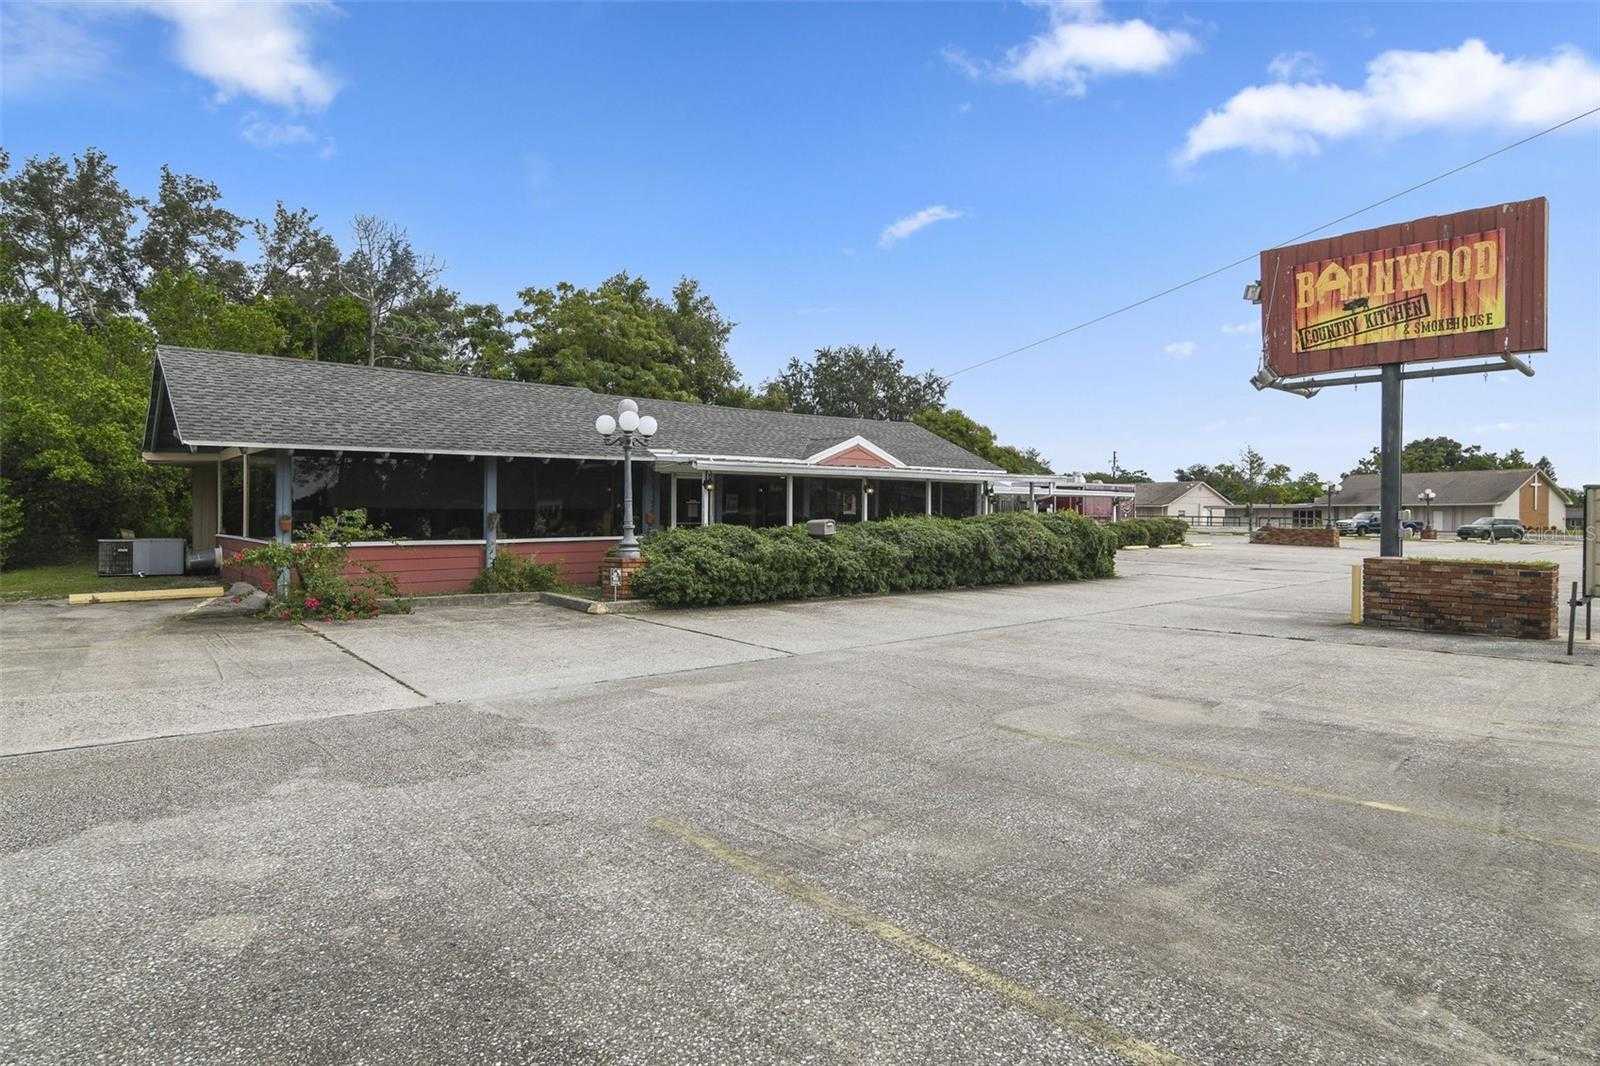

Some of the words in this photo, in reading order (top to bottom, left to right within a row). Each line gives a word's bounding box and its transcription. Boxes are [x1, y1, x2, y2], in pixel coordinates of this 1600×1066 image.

[1296, 240, 1498, 309] BARNWOOD
[1304, 315, 1359, 344] COUNTRY
[1365, 299, 1425, 329] KITCHEN
[1403, 322, 1411, 335] &
[1414, 312, 1494, 335] SMOKEHOUSE
